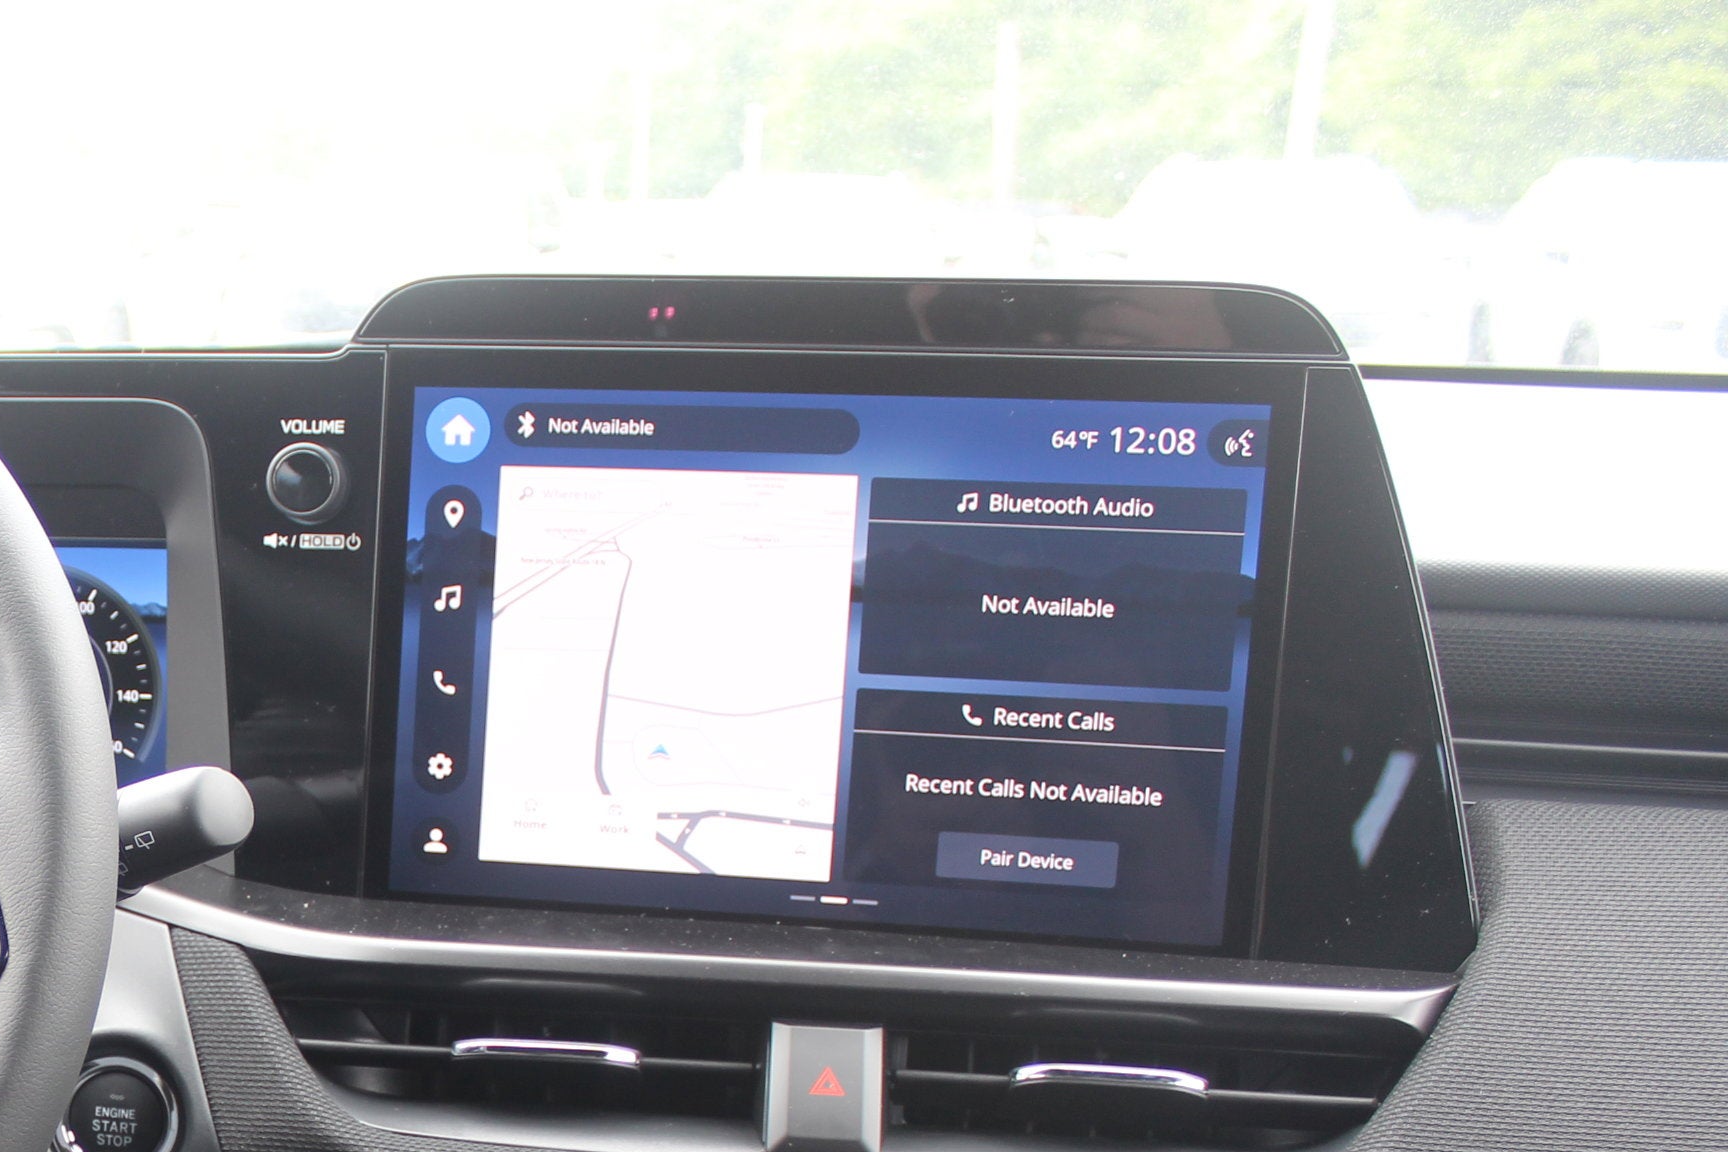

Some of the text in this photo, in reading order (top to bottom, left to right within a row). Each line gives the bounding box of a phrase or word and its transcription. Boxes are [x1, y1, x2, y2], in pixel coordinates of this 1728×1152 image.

[280, 419, 345, 435] VOLUME
[548, 418, 655, 436] Not Available
[1051, 430, 1099, 450] 64°F
[1109, 426, 1197, 456] 12:08
[988, 493, 1154, 518] Bluetooth Audio
[300, 534, 344, 548] HOLD
[78, 601, 95, 615] 00
[981, 594, 1115, 619] Not Available
[105, 640, 128, 654] 120
[116, 689, 140, 704] 140
[992, 706, 1115, 732] Recent Calls
[905, 773, 1163, 807] Recent Calls Not Available
[980, 848, 1074, 872] Pair Device
[95, 1106, 136, 1120] ENGINE
[92, 1119, 138, 1134] START
[97, 1133, 133, 1147] STOP
